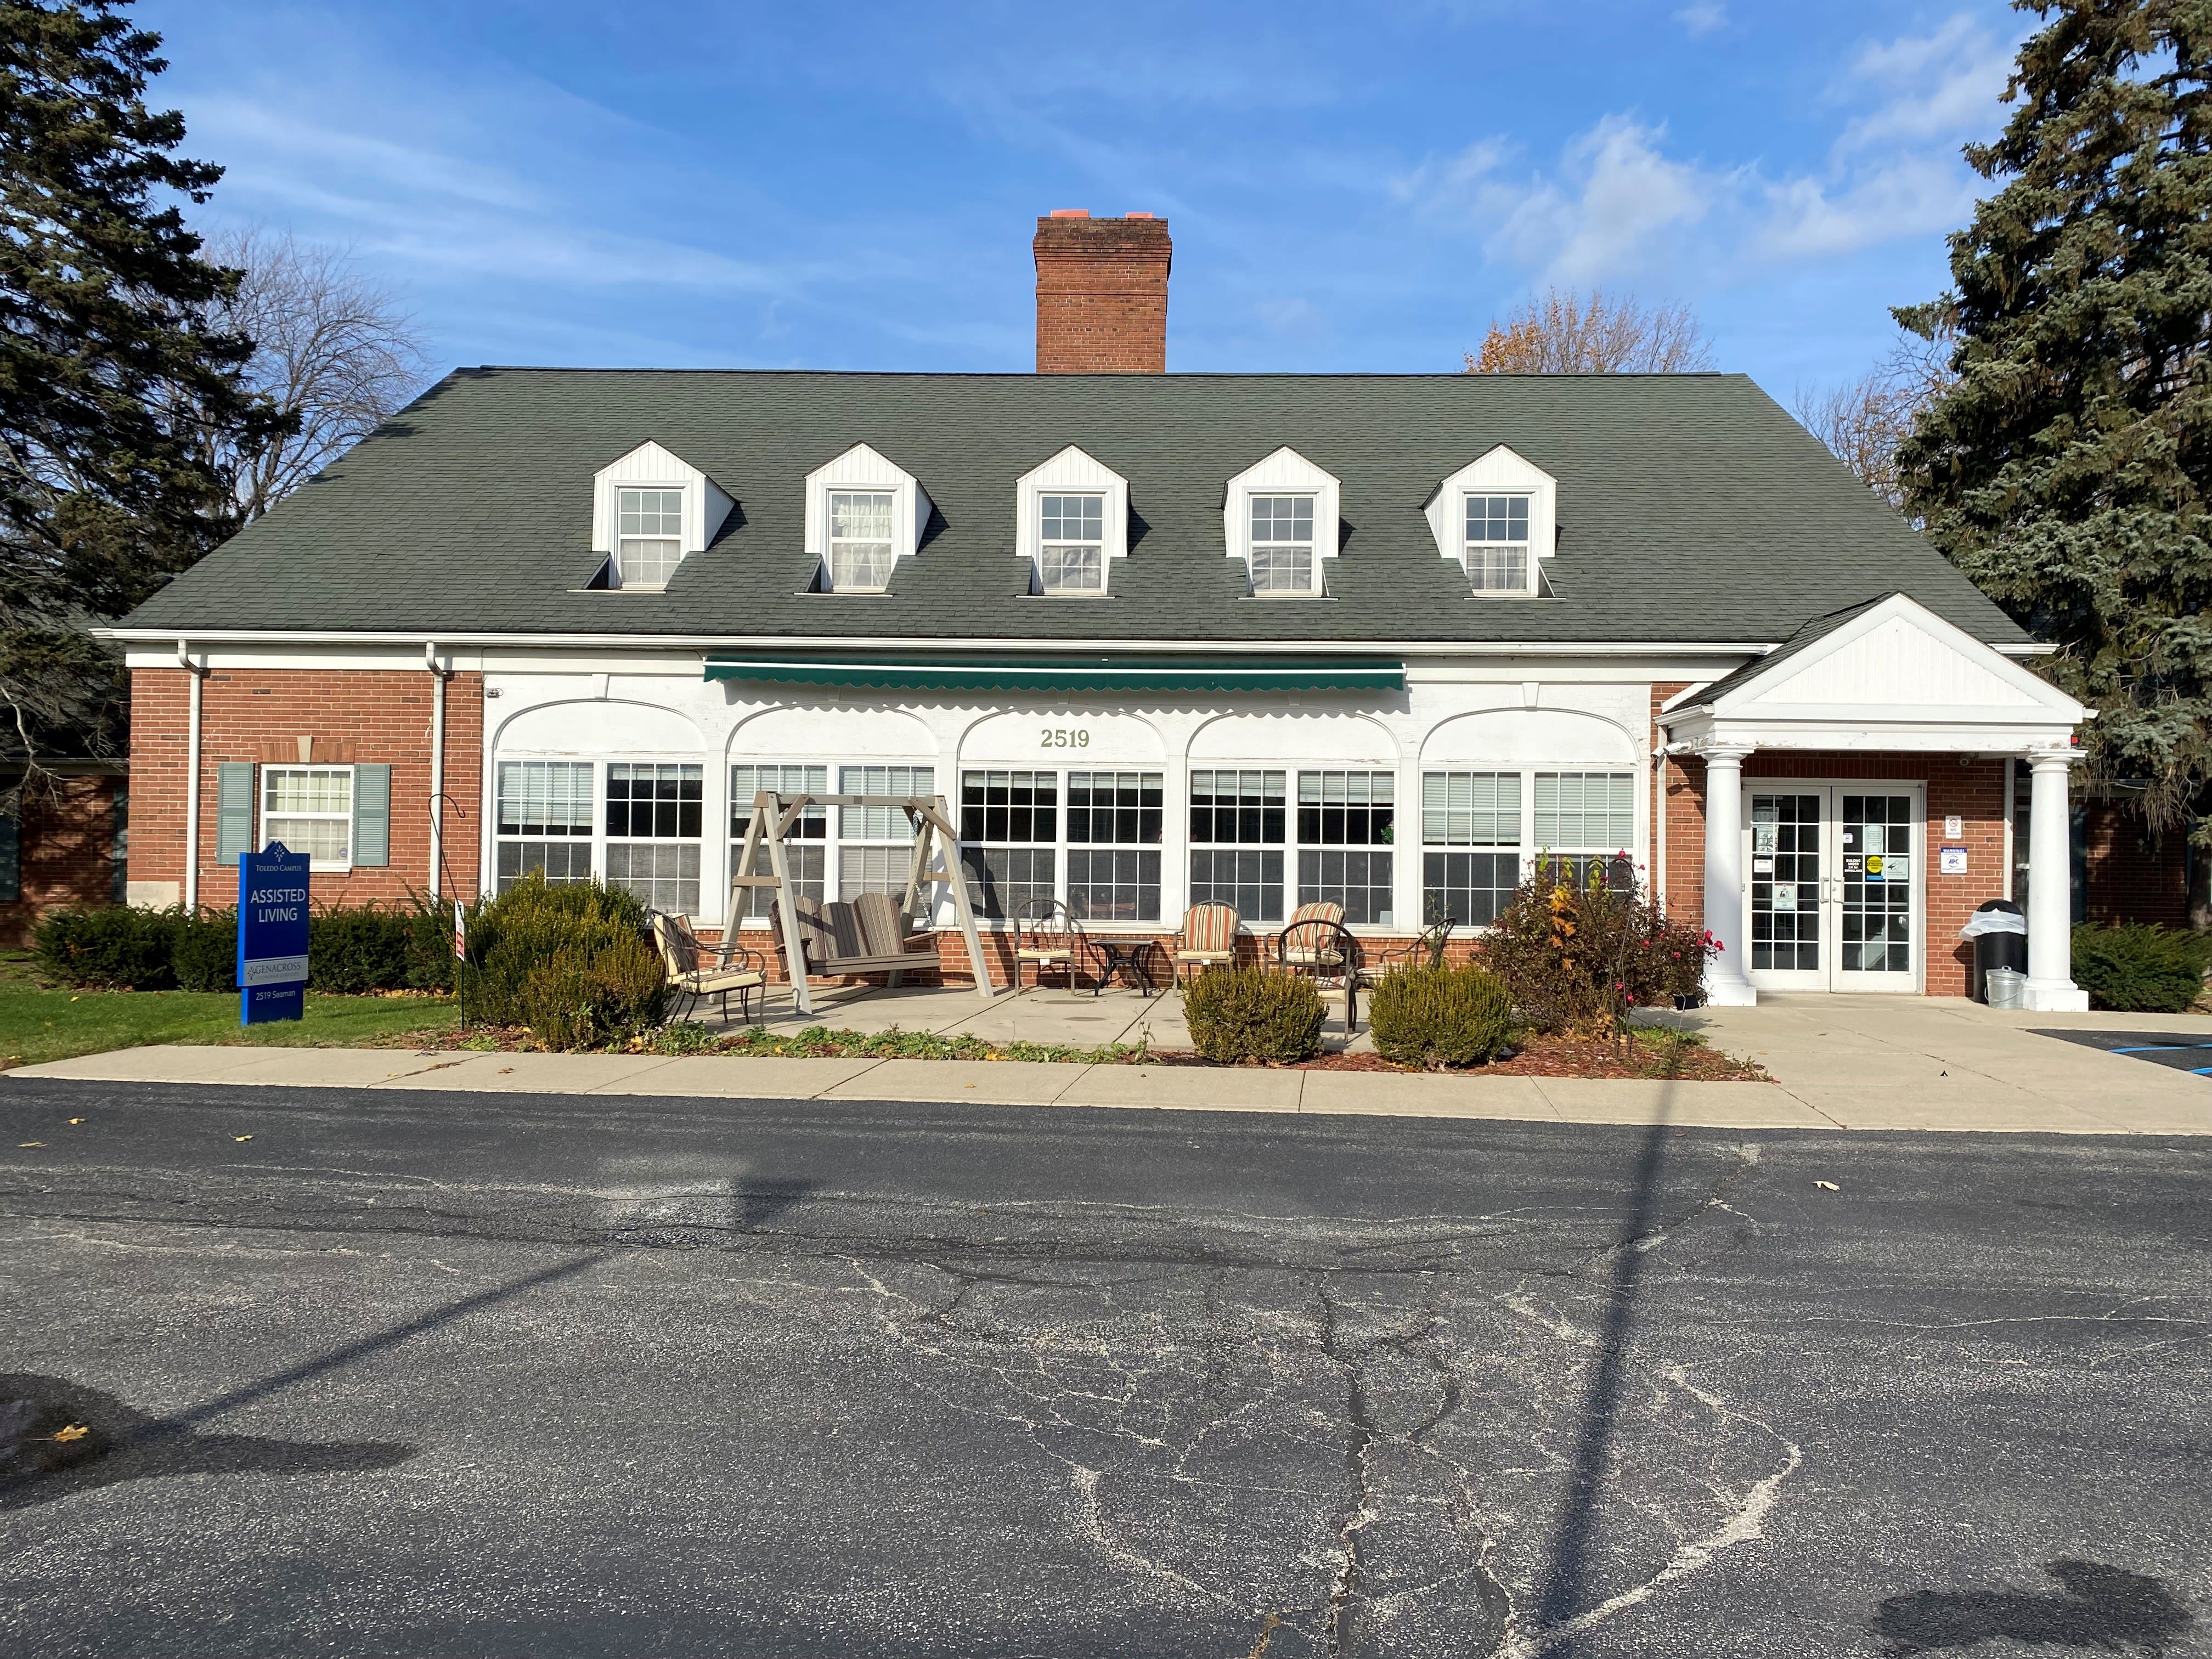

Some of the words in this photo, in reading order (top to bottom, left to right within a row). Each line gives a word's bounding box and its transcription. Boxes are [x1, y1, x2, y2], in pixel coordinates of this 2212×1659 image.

[1041, 729, 1090, 748] 2519
[250, 889, 306, 904] ASSISTED
[259, 907, 297, 922] LIVING
[255, 962, 301, 974] GENACROSS
[256, 992, 271, 1001] 2519
[273, 990, 296, 998] Seaman
